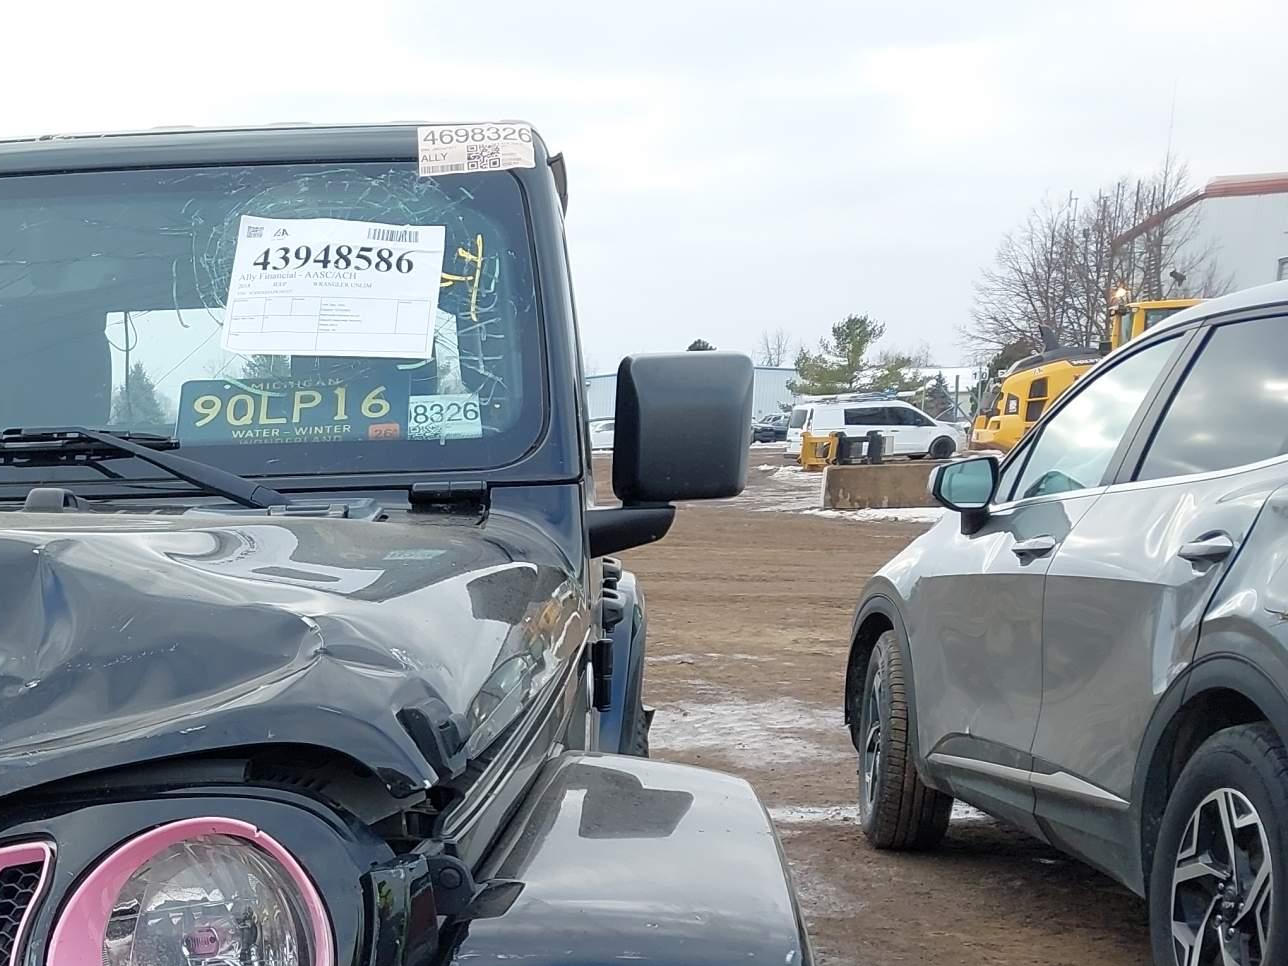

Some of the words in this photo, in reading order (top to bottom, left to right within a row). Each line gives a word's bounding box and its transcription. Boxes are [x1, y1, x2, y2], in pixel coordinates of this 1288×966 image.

[423, 127, 532, 145] 4698326
[421, 152, 448, 162] ALLY
[253, 244, 414, 274] 43948586
[239, 272, 257, 281] Ally
[259, 271, 297, 280] Financial
[305, 271, 357, 280] AASC/ACH
[409, 402, 479, 424] 8326
[231, 428, 280, 438] WATER
[294, 424, 352, 436] WINTER
